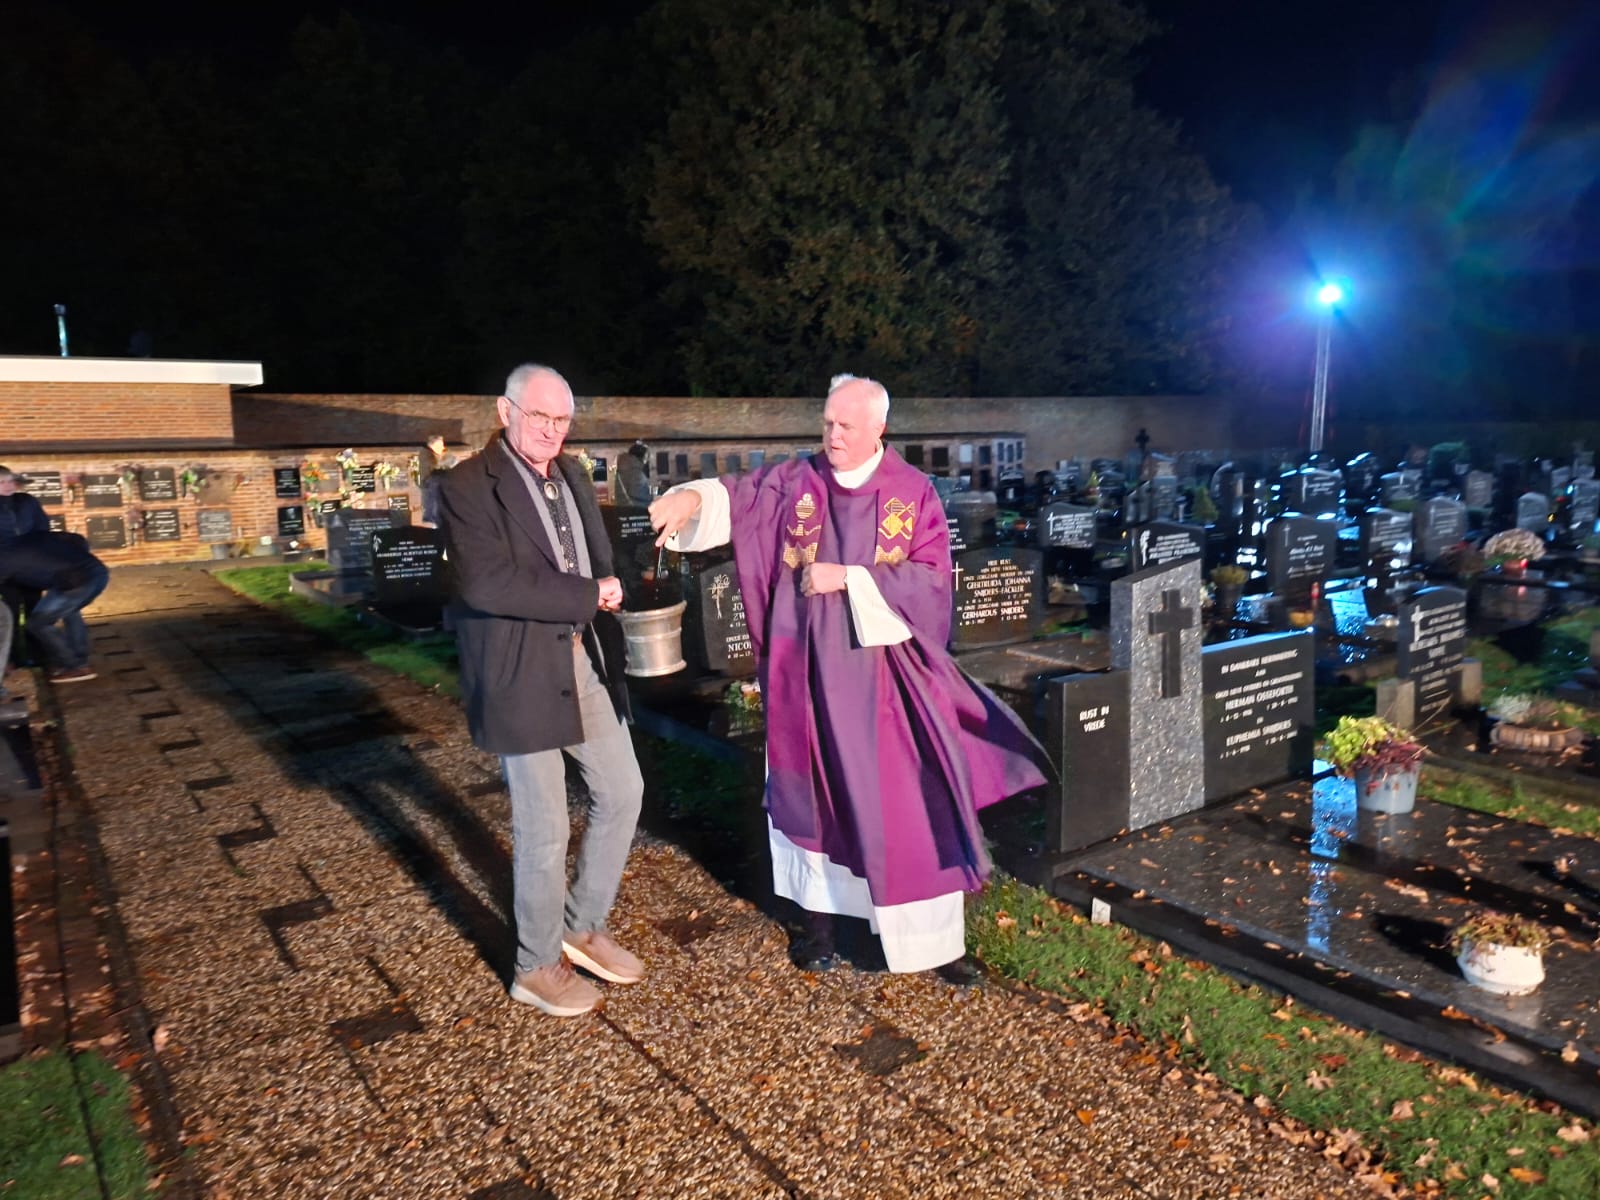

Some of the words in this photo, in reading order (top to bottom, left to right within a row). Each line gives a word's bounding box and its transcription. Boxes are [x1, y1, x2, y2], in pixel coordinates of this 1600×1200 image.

[1004, 576, 1031, 586] JOHANNA
[962, 608, 998, 620] GERHARDUS
[1079, 707, 1098, 722] RUST
[1101, 704, 1110, 716] IN
[1083, 718, 1106, 733] VREDE
